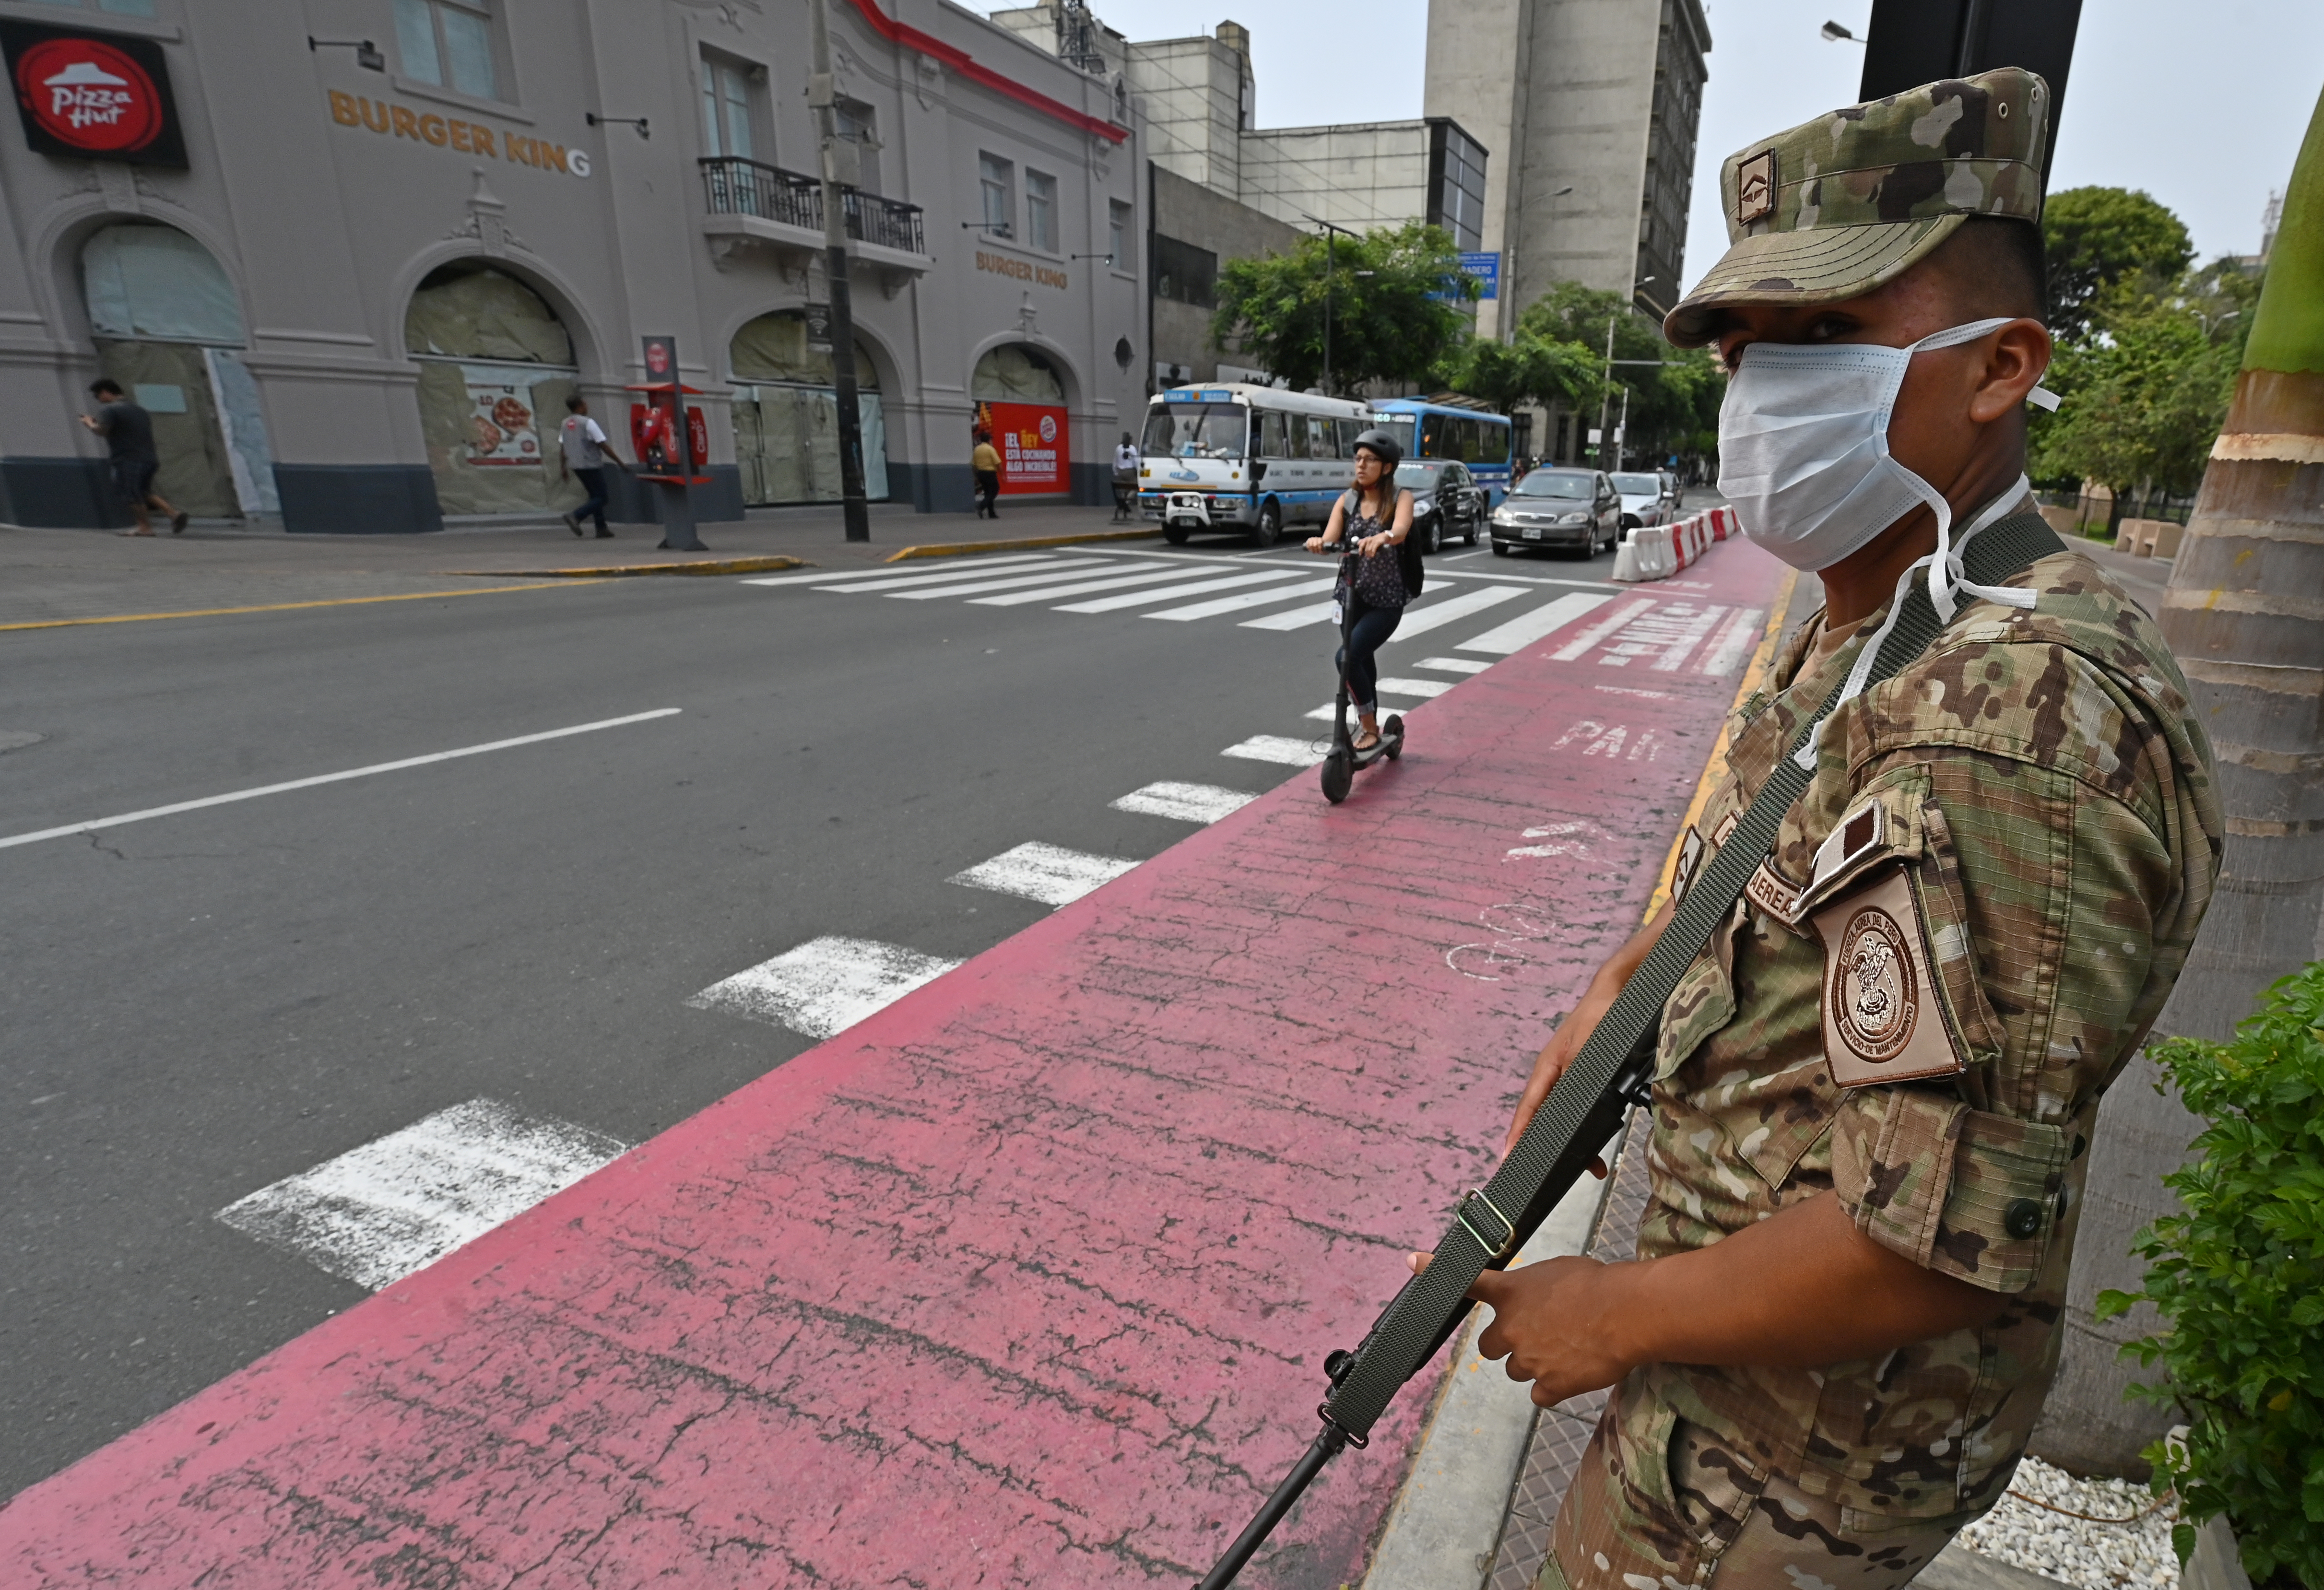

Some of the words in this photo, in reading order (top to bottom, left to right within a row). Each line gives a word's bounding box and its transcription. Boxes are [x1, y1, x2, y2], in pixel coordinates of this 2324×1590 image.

[51, 85, 133, 115] Pizza
[68, 106, 126, 129] Hut
[328, 89, 497, 158] BURGER
[503, 130, 591, 177] KING
[976, 250, 1032, 282] BURGER
[1749, 871, 1795, 917] AEREA
[1842, 930, 1856, 964] FUERZA
[1854, 913, 1871, 934] AEREA
[1872, 913, 1882, 928] DEL
[1841, 1020, 1864, 1050] SERVICIO
[1864, 1045, 1874, 1055] DE
